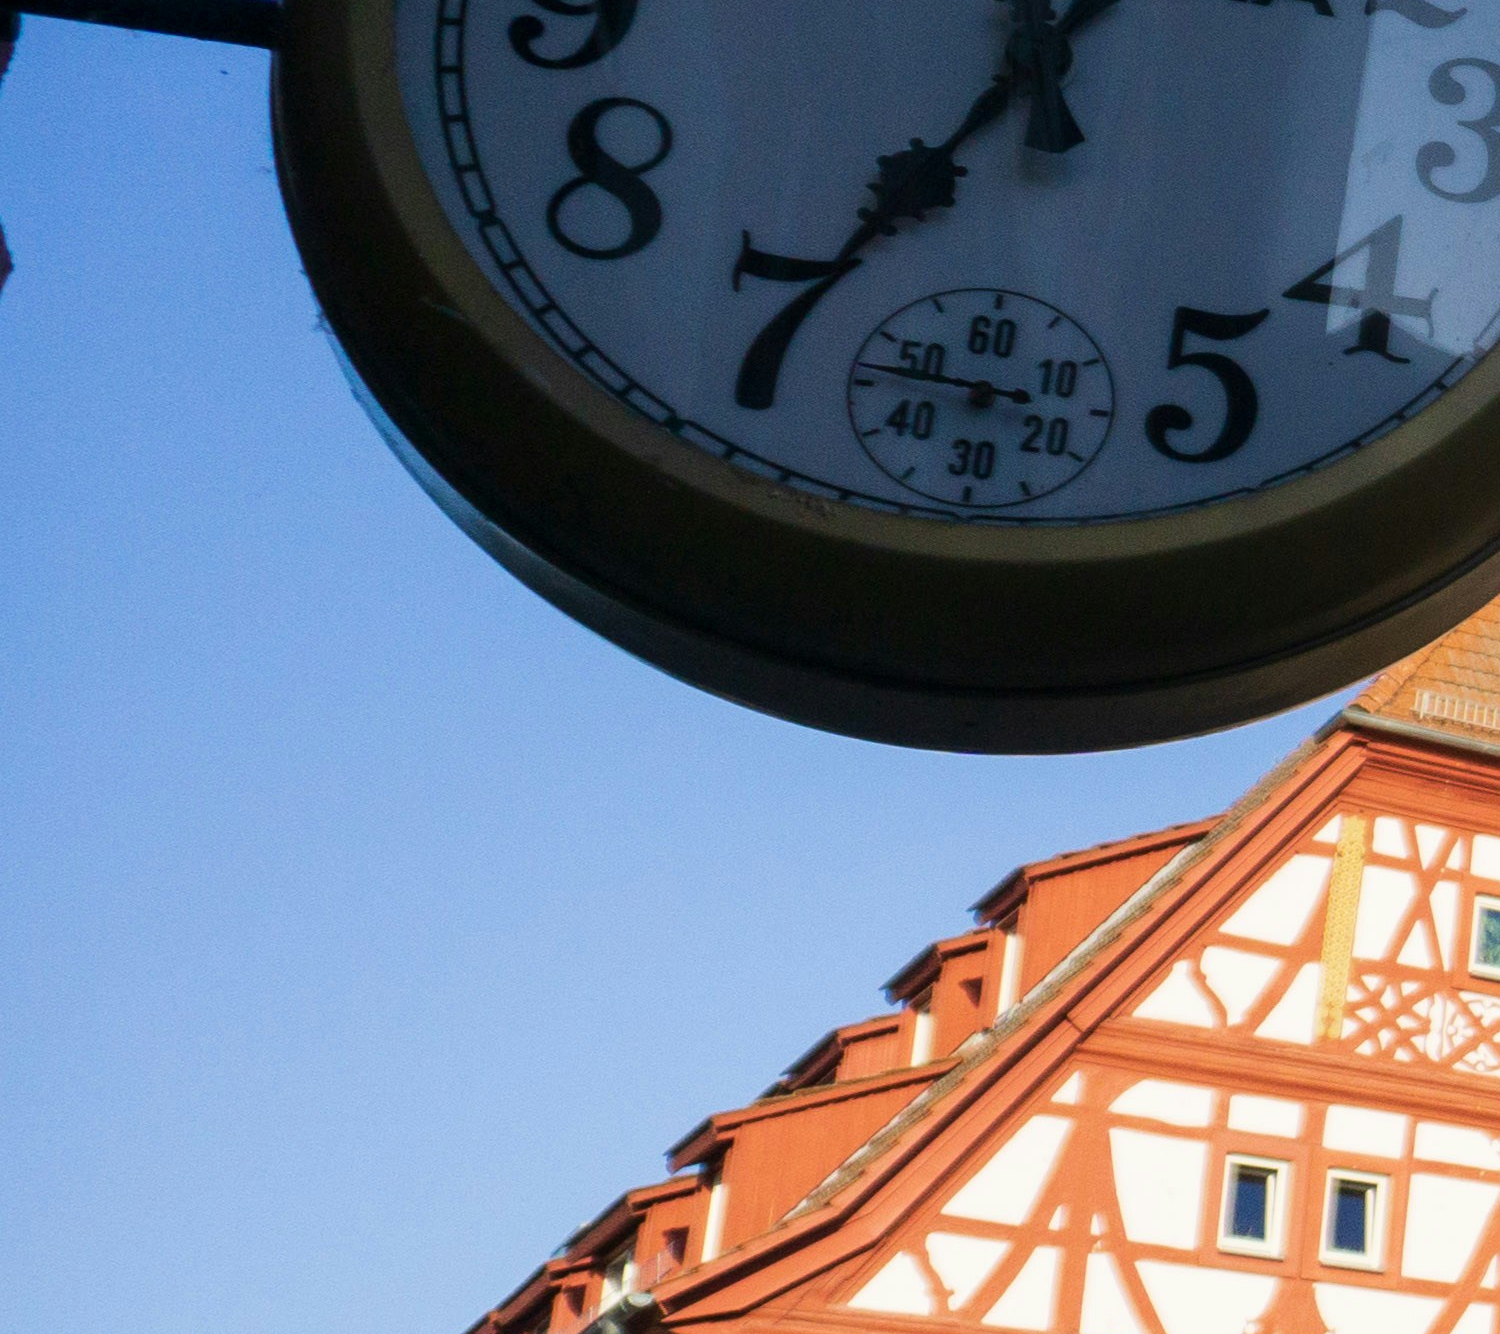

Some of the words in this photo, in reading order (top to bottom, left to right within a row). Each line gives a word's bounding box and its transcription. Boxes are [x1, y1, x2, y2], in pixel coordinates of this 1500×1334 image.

[544, 95, 673, 261] 8
[1280, 213, 1440, 366] 4
[730, 229, 864, 411] 7
[967, 314, 1017, 359] 60
[1038, 358, 1078, 399] 10
[1143, 305, 1274, 466] 5
[885, 399, 936, 441] 40
[1019, 414, 1069, 457] 20
[948, 437, 996, 481] 30
